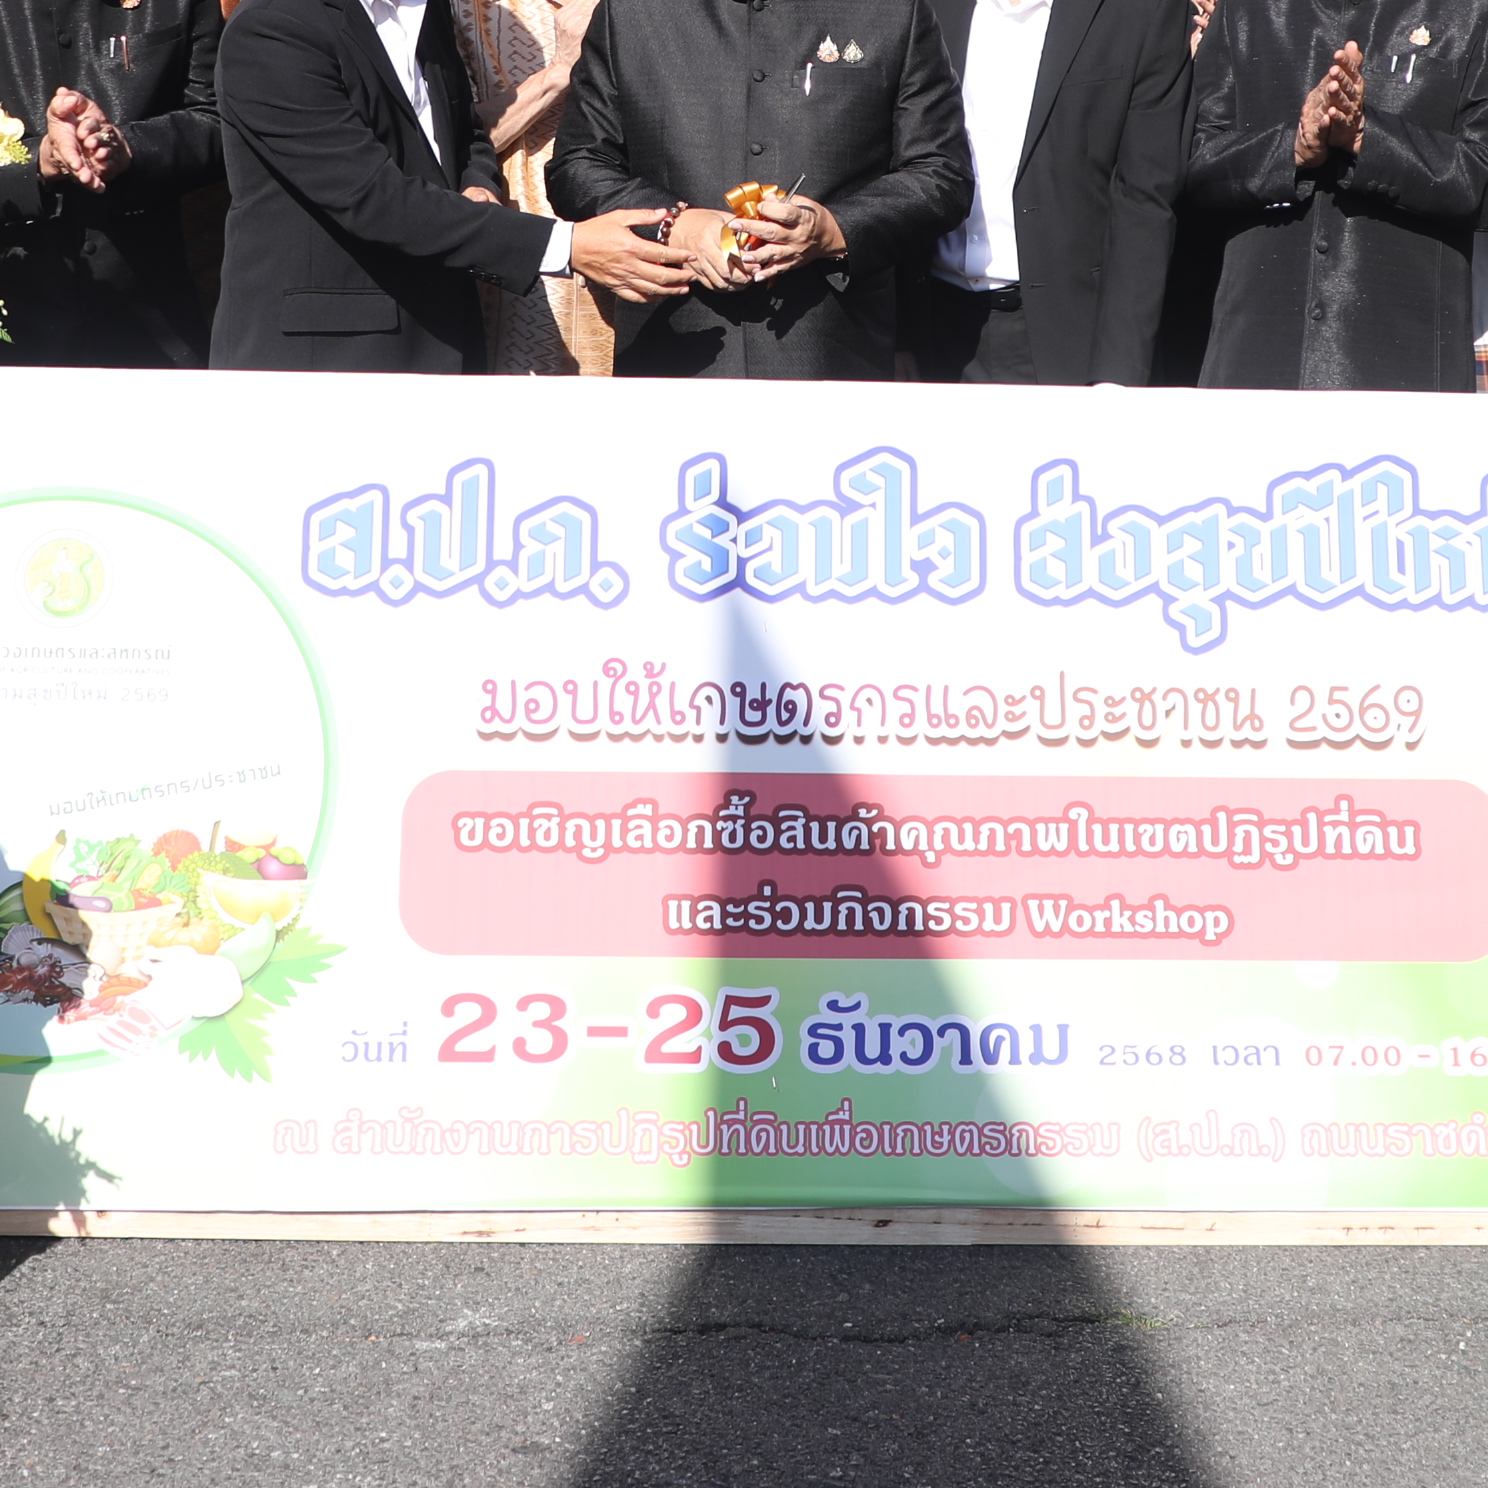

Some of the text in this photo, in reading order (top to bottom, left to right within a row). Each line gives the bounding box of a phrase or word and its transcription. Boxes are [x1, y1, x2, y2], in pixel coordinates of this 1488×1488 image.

[302, 457, 630, 610] ส.ป.ก.
[659, 445, 986, 606] ร่วมใจ
[9, 666, 74, 674] AGRICULTURE
[77, 667, 99, 675] AND
[101, 667, 171, 676] COOPERATIVES
[120, 687, 170, 702] 2569
[478, 657, 1425, 736] มอบให้เกษตรกรและประชาชน 2569
[48, 763, 282, 817] มอบให้เกษตรกร/ประชาชน
[456, 794, 1417, 866] ขอเชิญเลือกซื้อสินค้าคุณภาพในเขตปฏิรูปที่ดิน
[666, 885, 1231, 942] และร่วมกิจกรรม Workshop
[340, 1020, 409, 1064] วันที่
[436, 992, 778, 1067] 23-25
[806, 997, 1070, 1067] ธันวาคม
[1097, 1043, 1188, 1069] 2568
[1211, 1043, 1282, 1068] เวลา
[1304, 1044, 1402, 1069] 07.00
[273, 1117, 319, 1155] ณ
[331, 1097, 1121, 1168] สำนักงานการปฏิรูปที่ดินเพื่อเกษตรกรรม
[1136, 1110, 1286, 1163] (ส.ป.ก.)
